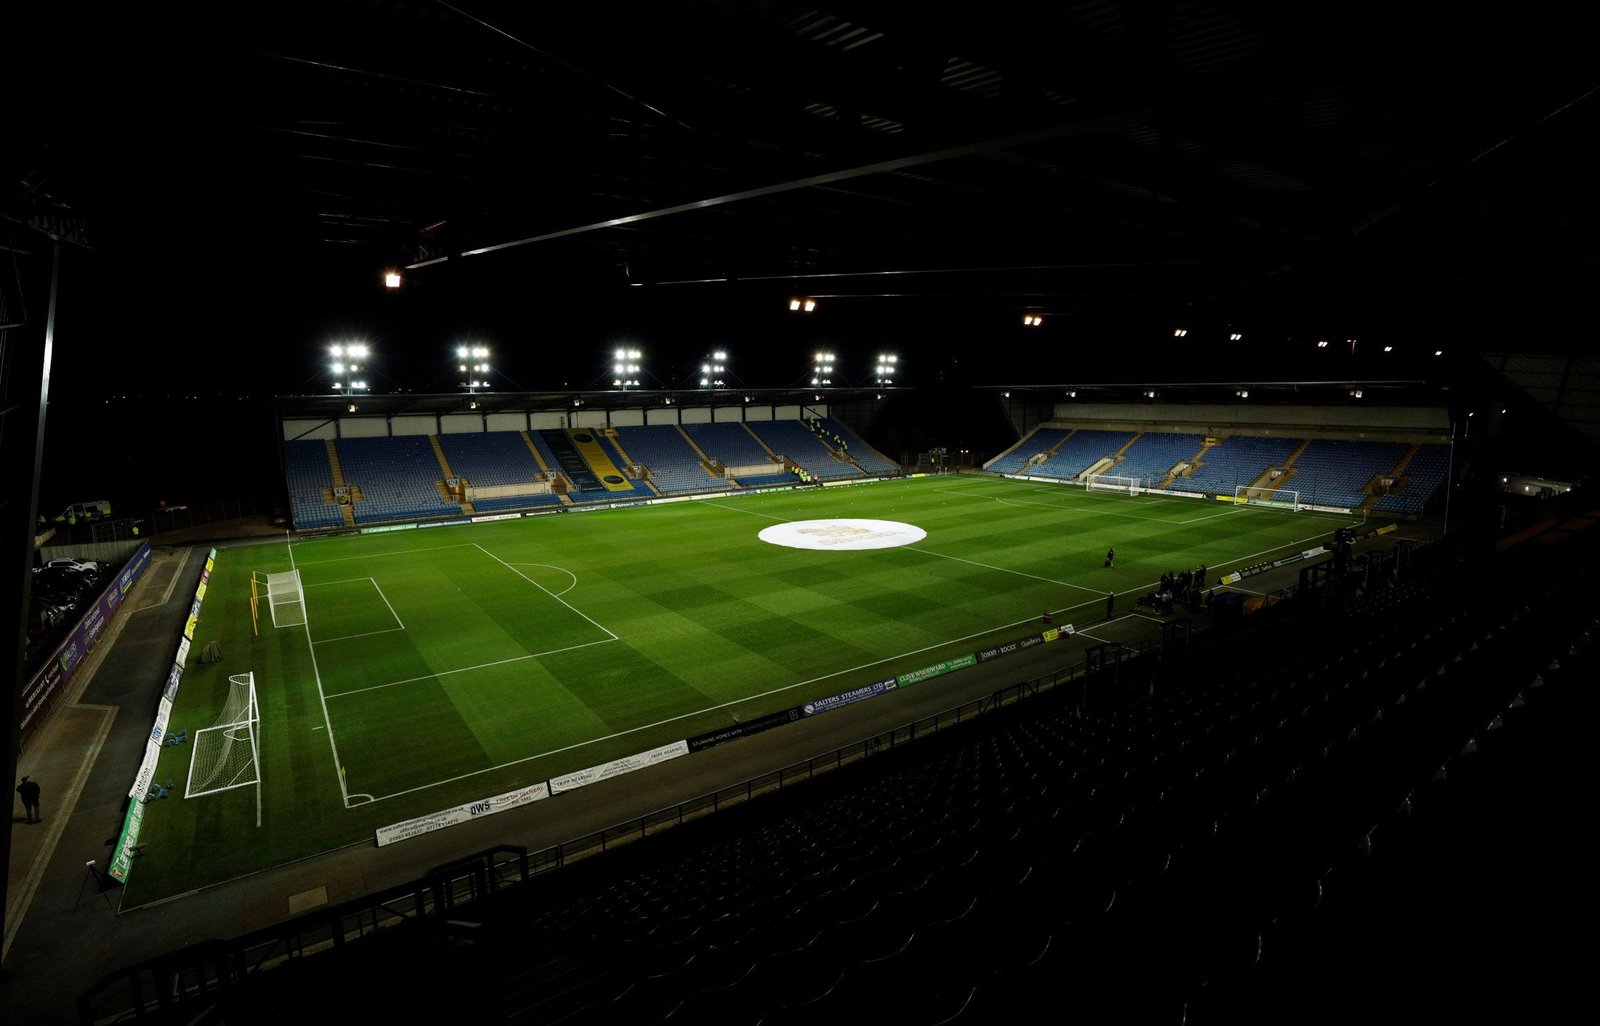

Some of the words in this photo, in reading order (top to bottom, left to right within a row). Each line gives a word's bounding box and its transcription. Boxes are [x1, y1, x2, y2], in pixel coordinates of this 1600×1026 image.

[899, 672, 915, 682] CLIVE
[814, 695, 840, 707] SALTERS
[841, 685, 872, 700] STEAMERS
[872, 682, 884, 690] LTD
[663, 746, 683, 755] HEARING
[470, 800, 490, 815] OWS
